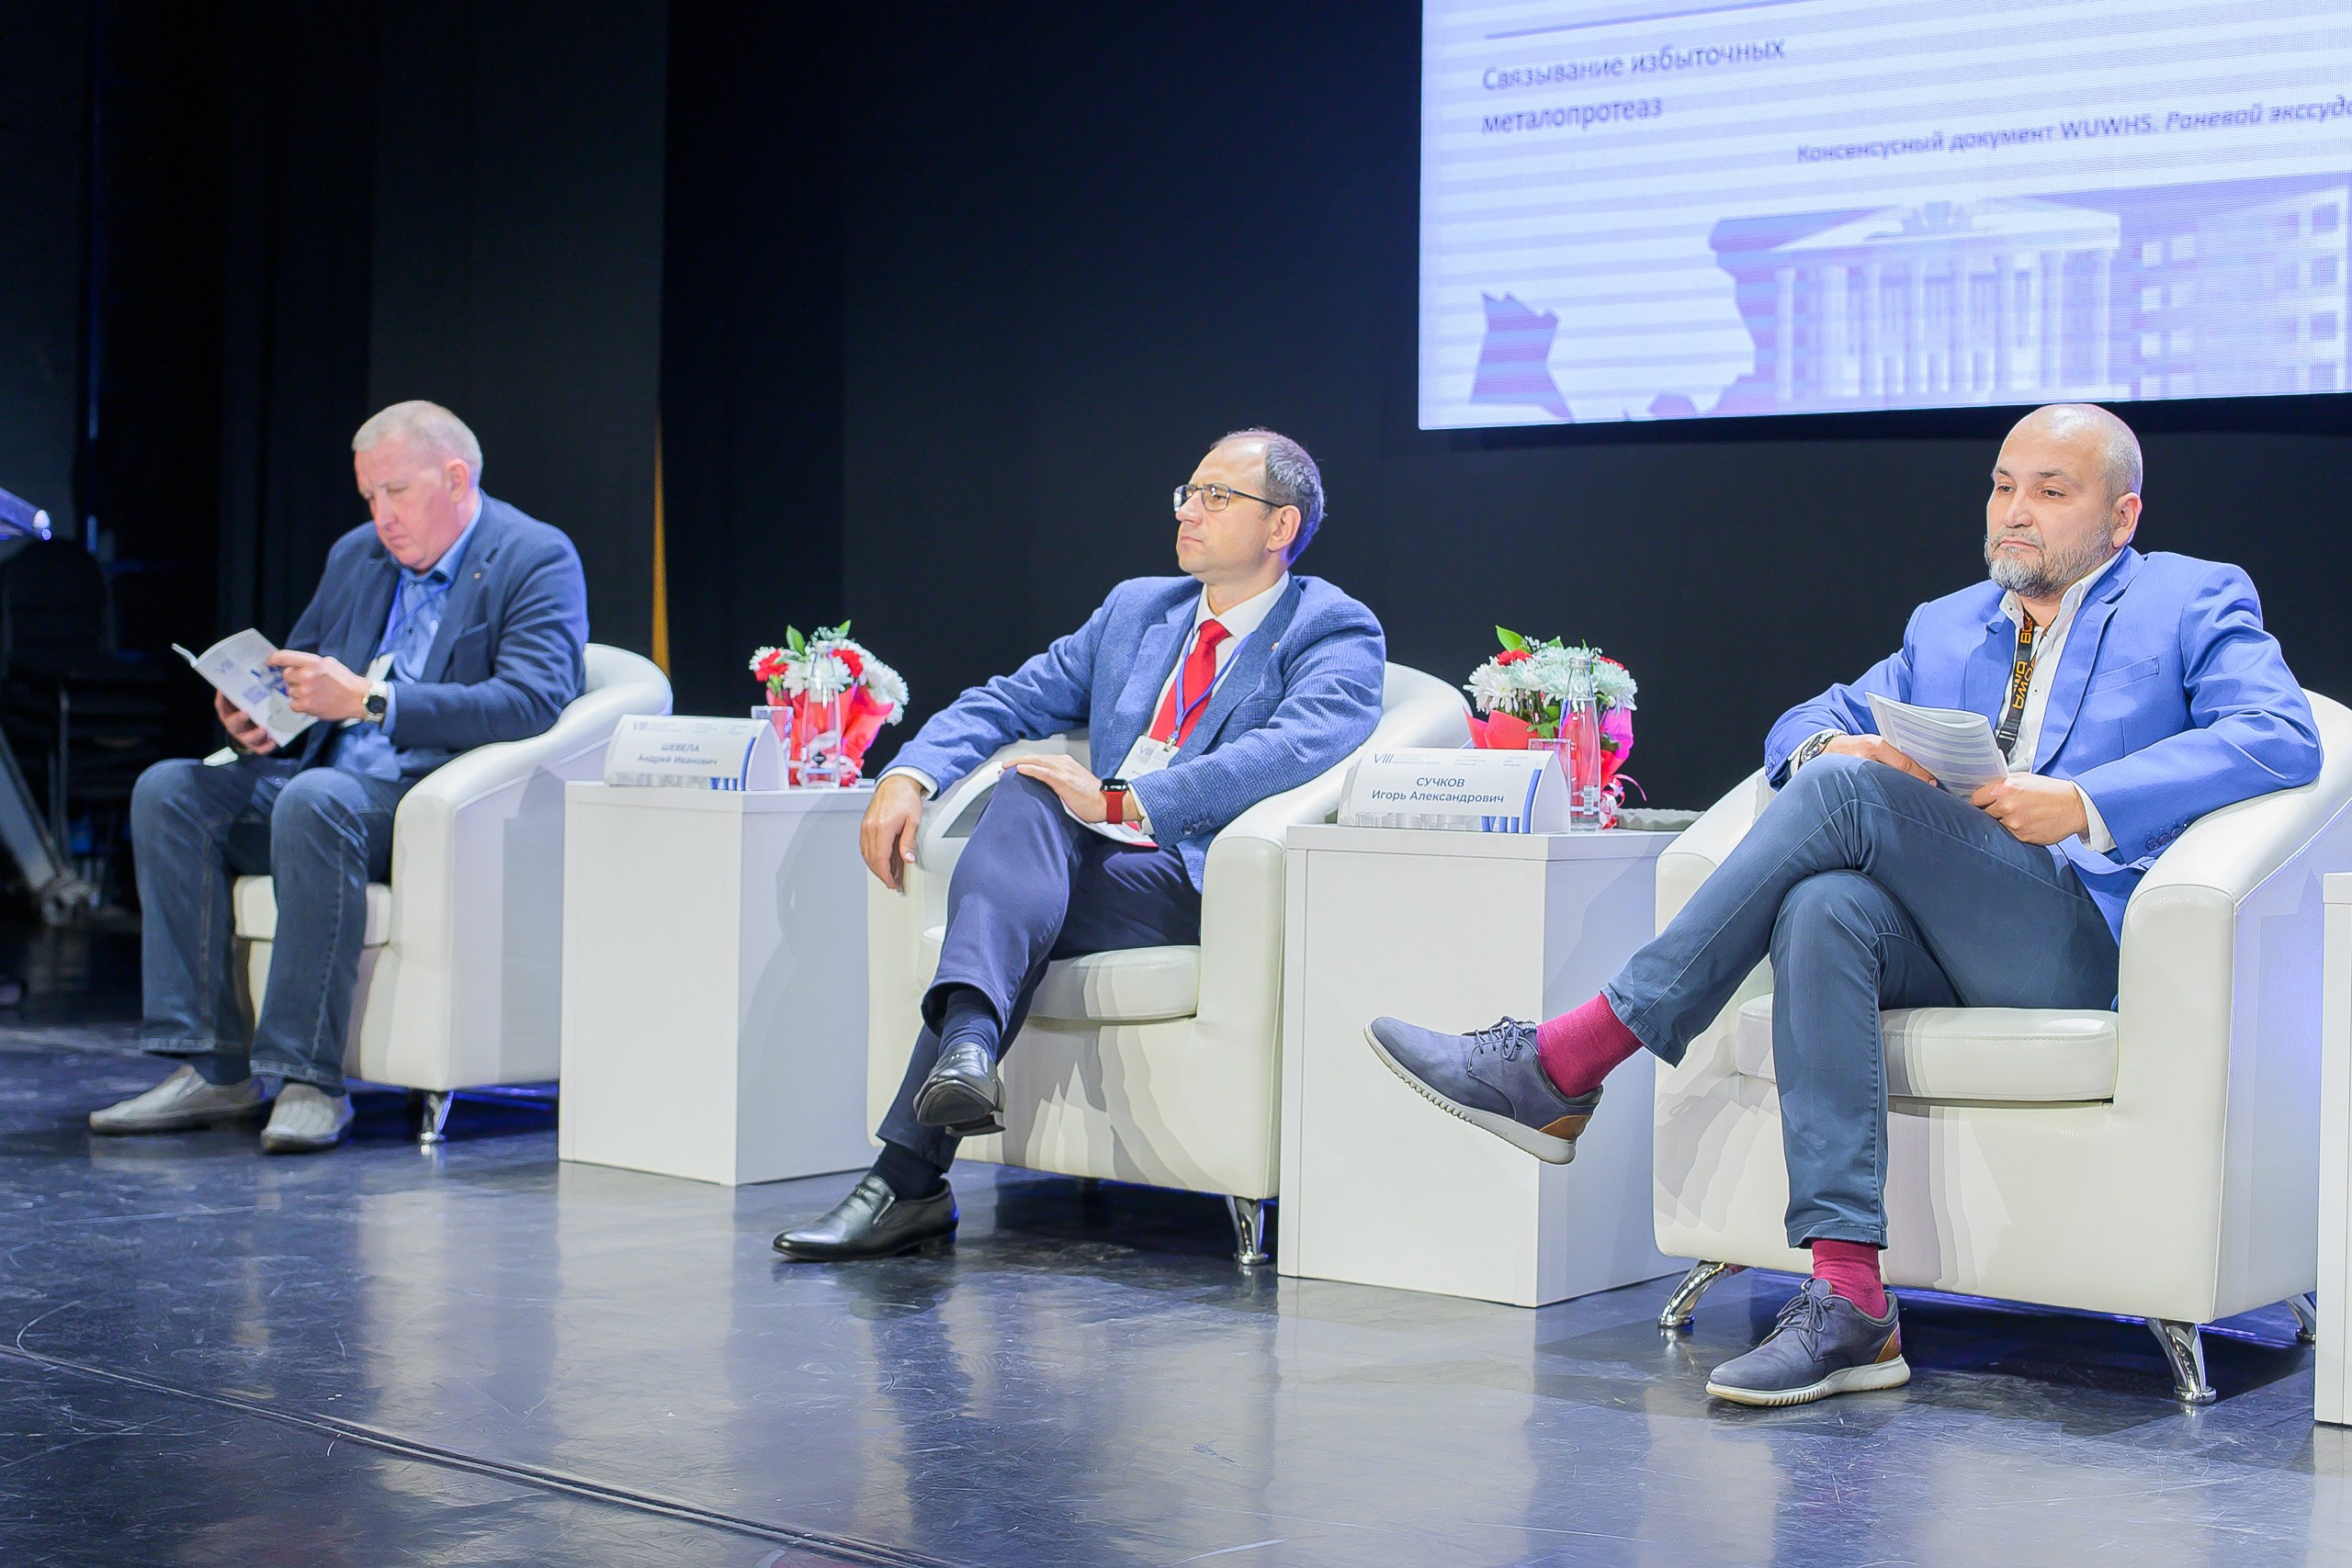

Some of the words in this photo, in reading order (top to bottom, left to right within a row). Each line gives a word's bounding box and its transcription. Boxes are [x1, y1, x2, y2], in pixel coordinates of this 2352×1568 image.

[1482, 55, 1624, 91] Связывание
[1630, 38, 1786, 74] избыточных
[1481, 96, 1663, 134] металопротеаз
[1797, 130, 1944, 164] Консенсусный
[1949, 124, 2053, 153] документ
[661, 742, 700, 751] ШЕВЕЛА
[638, 753, 672, 764] Андрей
[1374, 752, 1395, 764] VIII
[1415, 776, 1465, 788] СУЧКОВ
[1372, 790, 1407, 803] Игорь
[1409, 790, 1505, 804] Александрович
